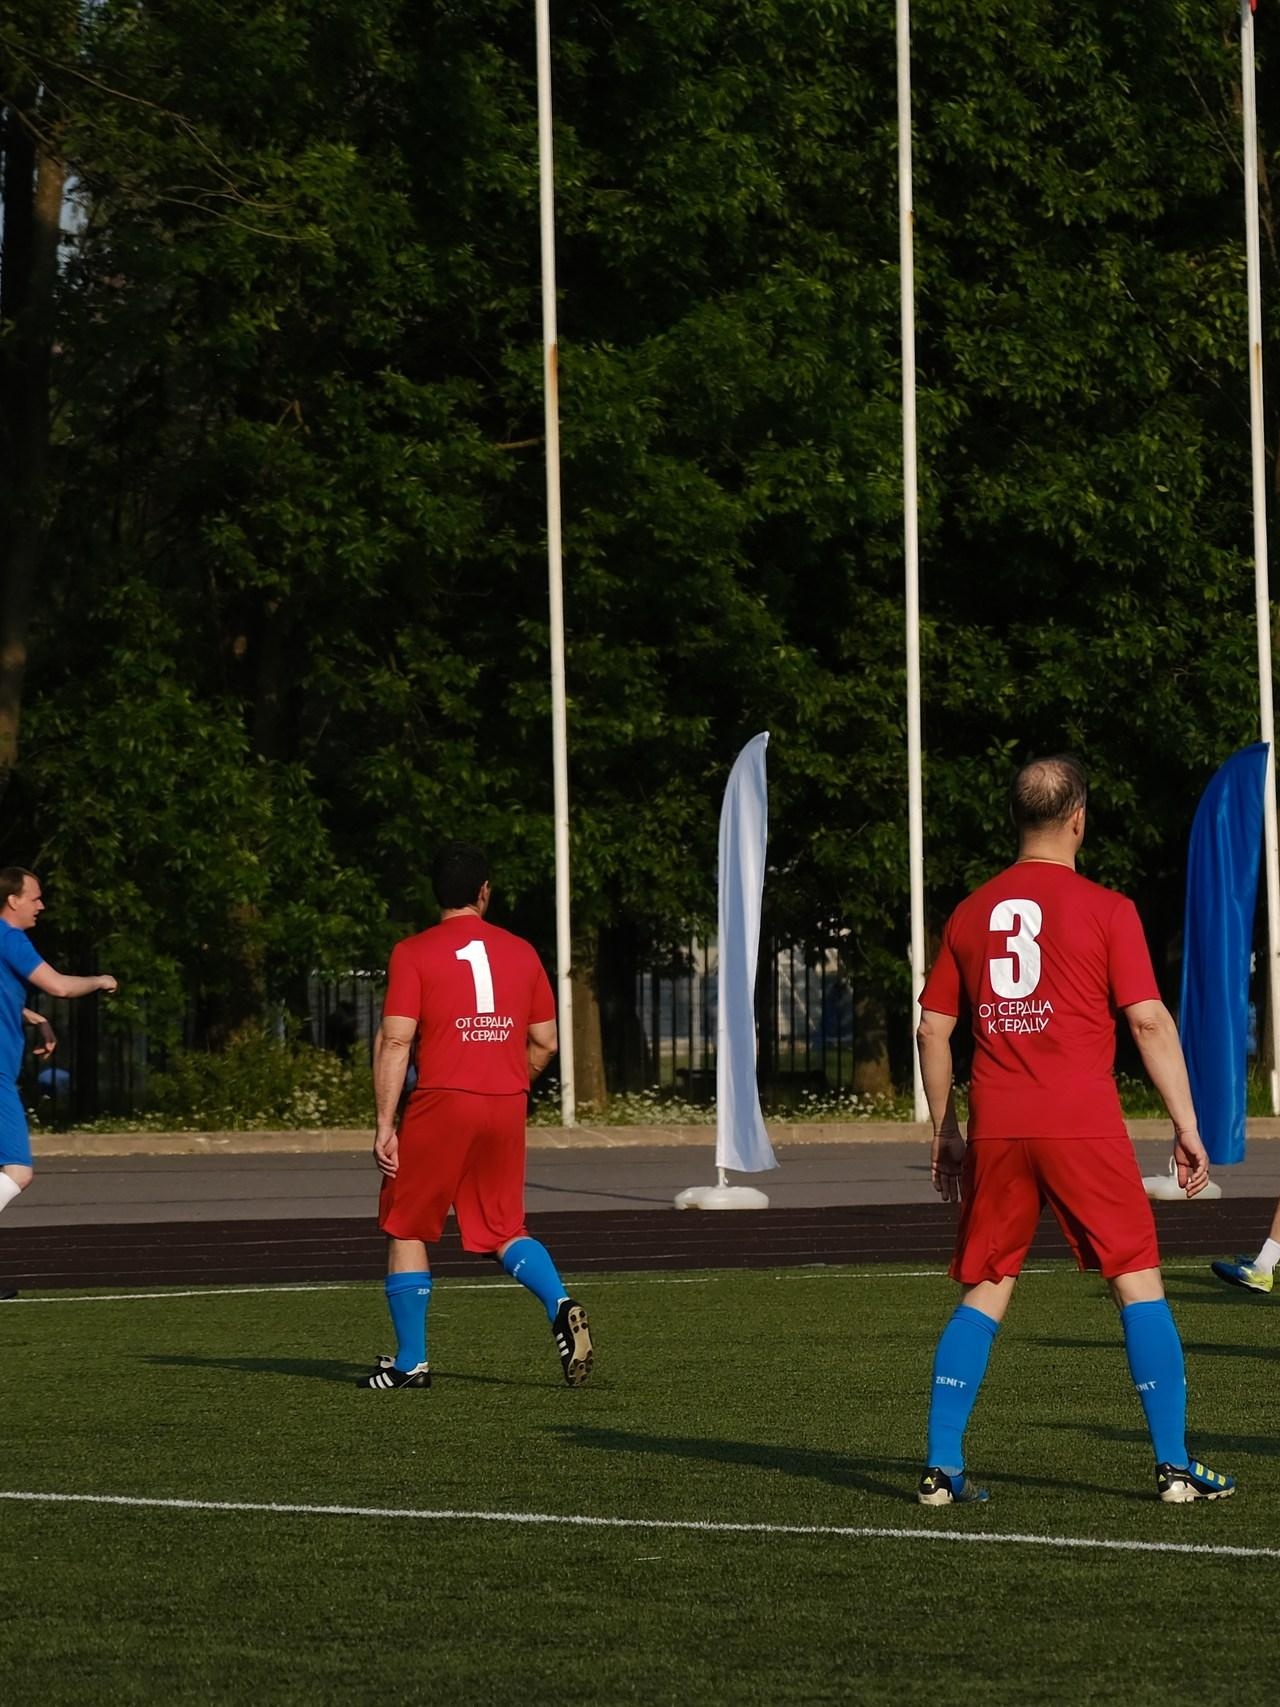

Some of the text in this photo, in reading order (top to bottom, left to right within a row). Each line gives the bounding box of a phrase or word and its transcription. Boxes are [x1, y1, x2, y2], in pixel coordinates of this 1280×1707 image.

[989, 898, 1043, 999] 3
[455, 940, 495, 1014] 1
[978, 999, 1054, 1018] ОТ СЕРДЦА
[455, 1016, 514, 1029] ОТ СЕРДЦА
[987, 1017, 1049, 1035] К СЕРДЦУ
[462, 1030, 510, 1042] К СЕРДЦУ
